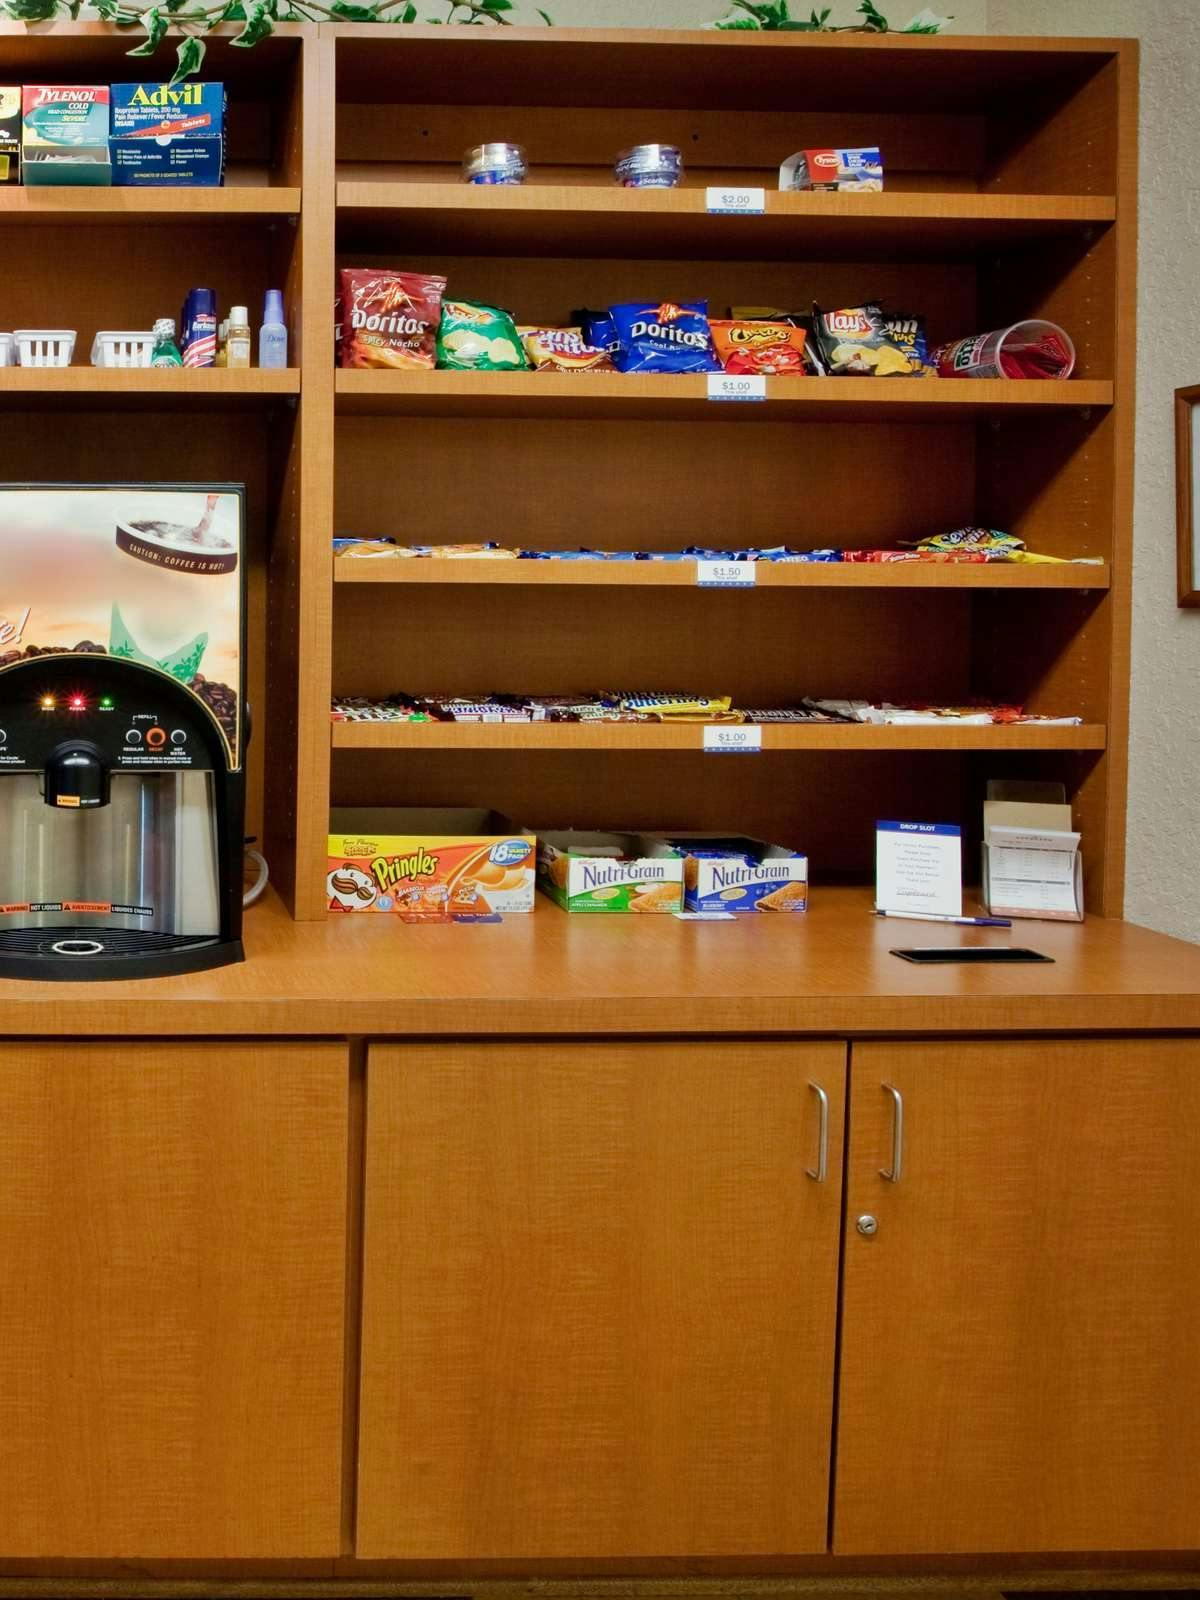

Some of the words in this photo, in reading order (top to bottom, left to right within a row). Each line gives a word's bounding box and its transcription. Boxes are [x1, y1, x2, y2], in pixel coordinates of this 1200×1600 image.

[37, 88, 97, 103] TYLENOL
[127, 84, 202, 106] Advil
[68, 102, 89, 110] COLD
[721, 194, 750, 204] $2.00
[352, 308, 430, 335] Doritos
[267, 334, 286, 343] Dove
[629, 320, 709, 350] Doritos
[389, 338, 420, 348] Nacho
[649, 339, 667, 349] Cool
[722, 382, 751, 391] $1.00
[129, 543, 161, 561] CAUTION:
[164, 556, 195, 569] COFFEE
[198, 562, 207, 570] IS
[208, 562, 225, 571] HOT!
[712, 567, 741, 576] $1.50
[718, 733, 746, 741] $1.00
[489, 844, 508, 862] 18
[370, 847, 440, 894] Pringles
